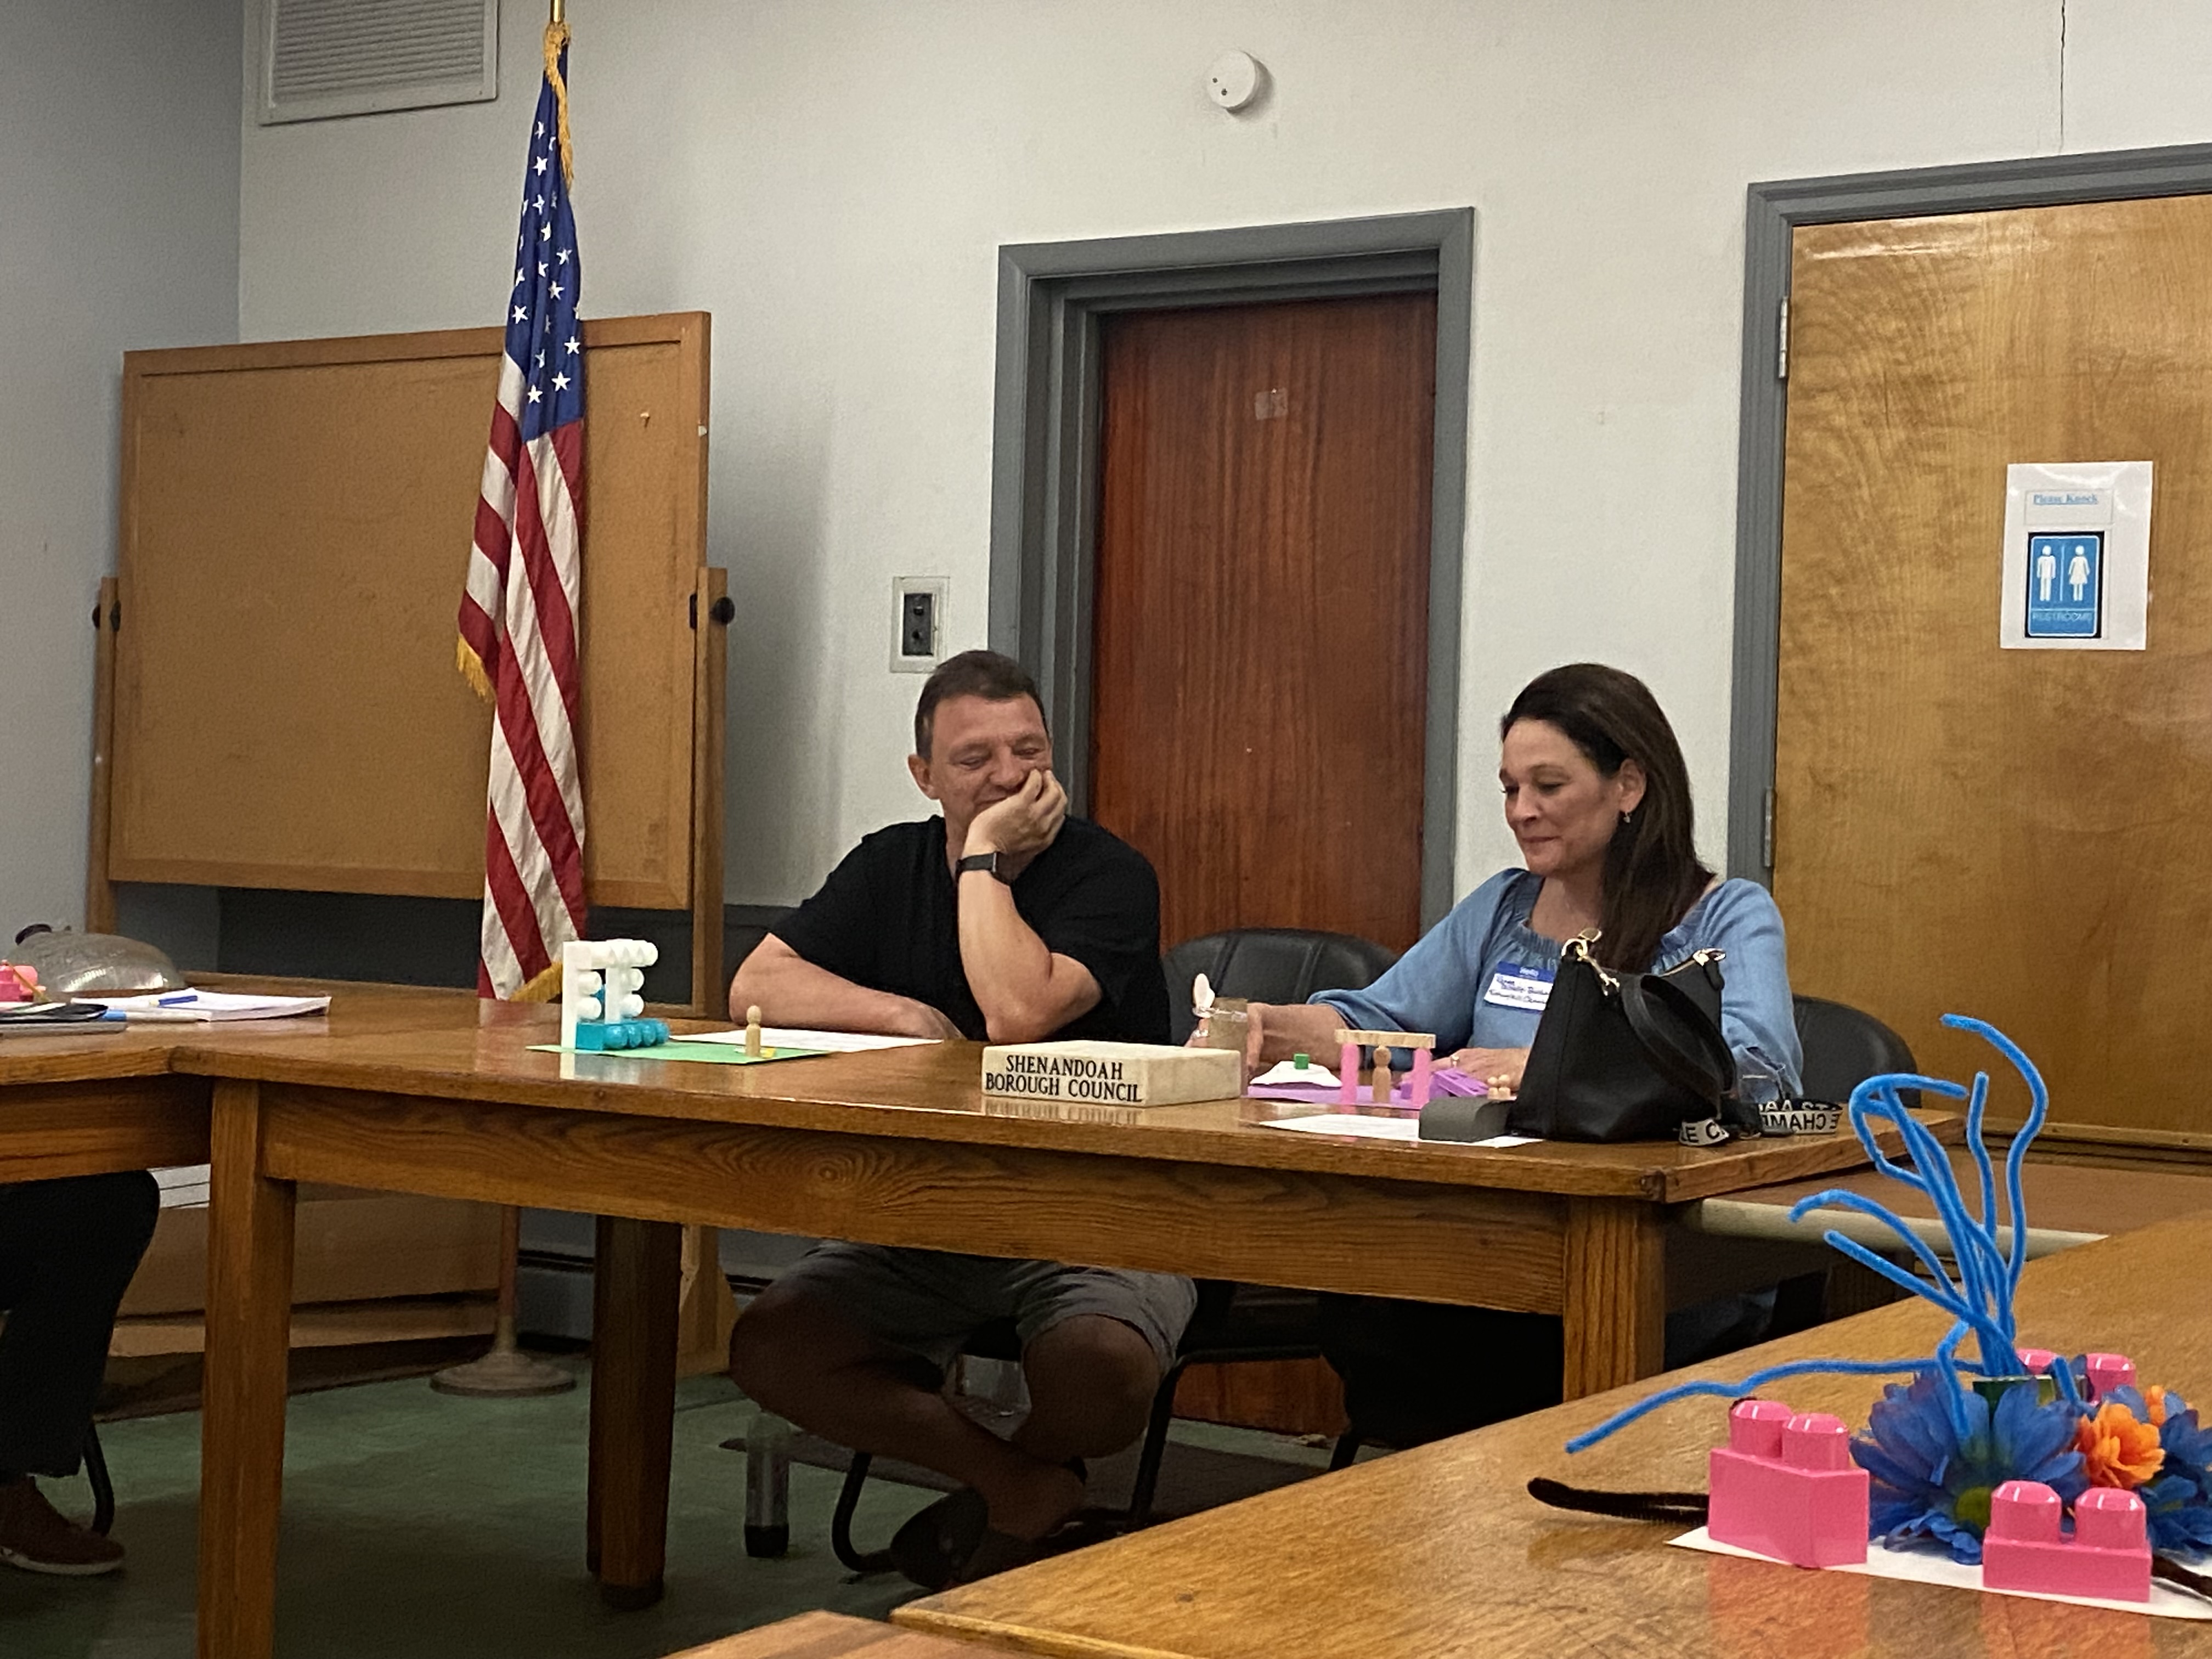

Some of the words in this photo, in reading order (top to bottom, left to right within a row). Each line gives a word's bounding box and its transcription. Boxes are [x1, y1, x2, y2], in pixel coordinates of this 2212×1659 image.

[1006, 1054, 1123, 1080] SHENANDOAH
[985, 1072, 1059, 1096] BOROUGH
[1068, 1079, 1143, 1102] COUNCIL
